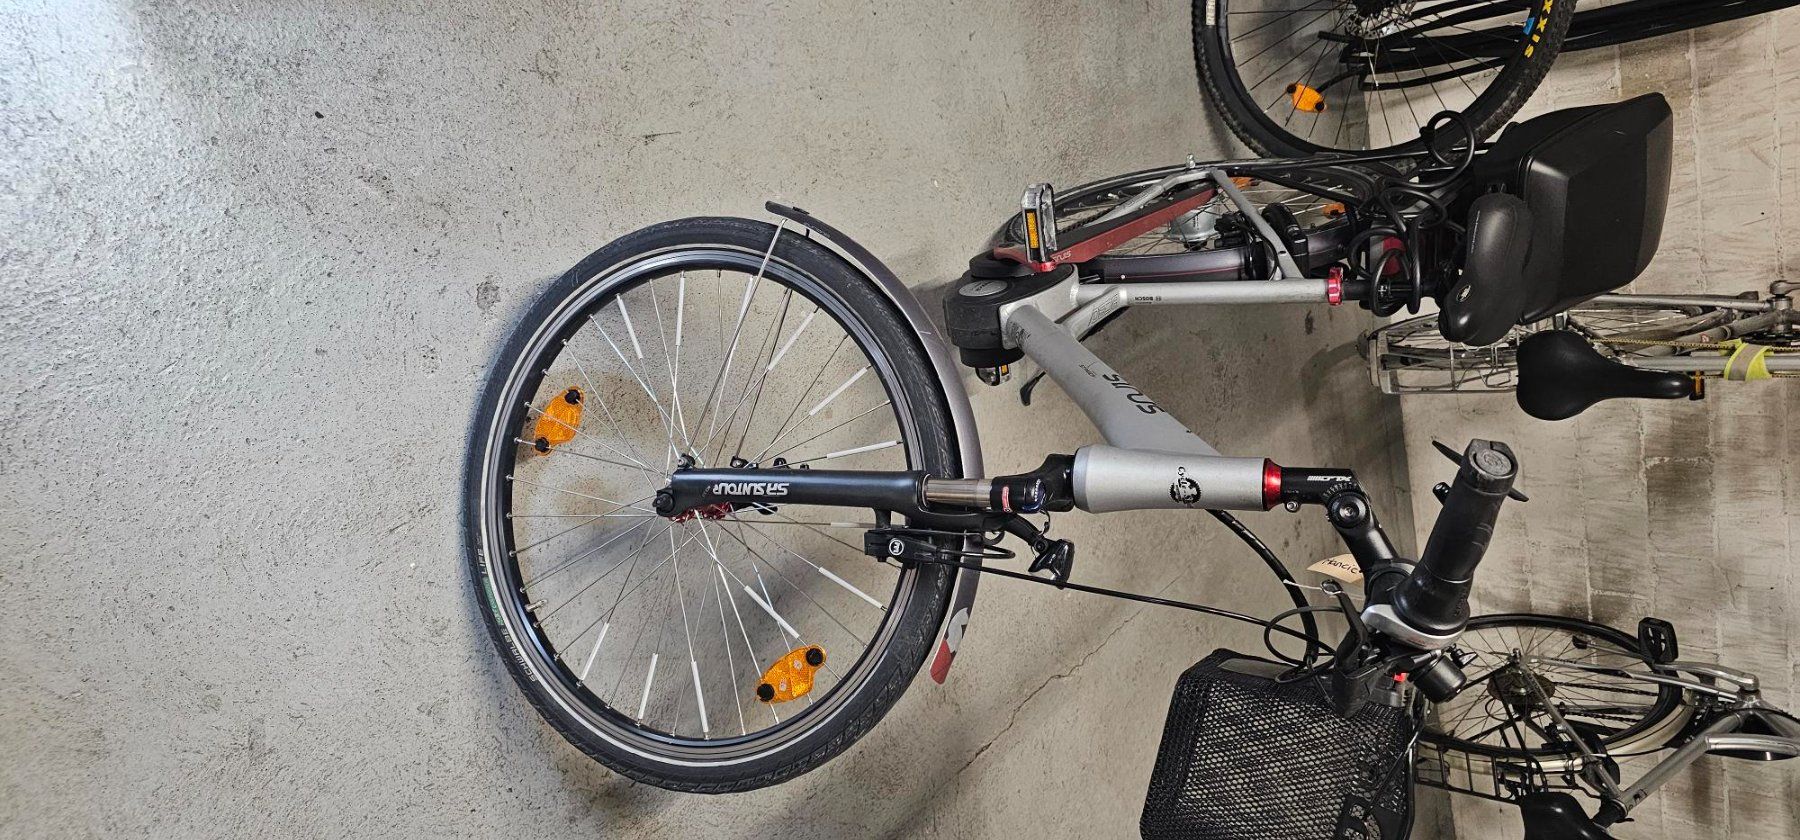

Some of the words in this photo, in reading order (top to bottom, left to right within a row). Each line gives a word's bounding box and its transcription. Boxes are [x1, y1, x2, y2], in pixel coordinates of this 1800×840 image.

[712, 483, 767, 495] SUNTOUR
[766, 483, 790, 495] SR
[501, 627, 537, 682] SCHWALBE
